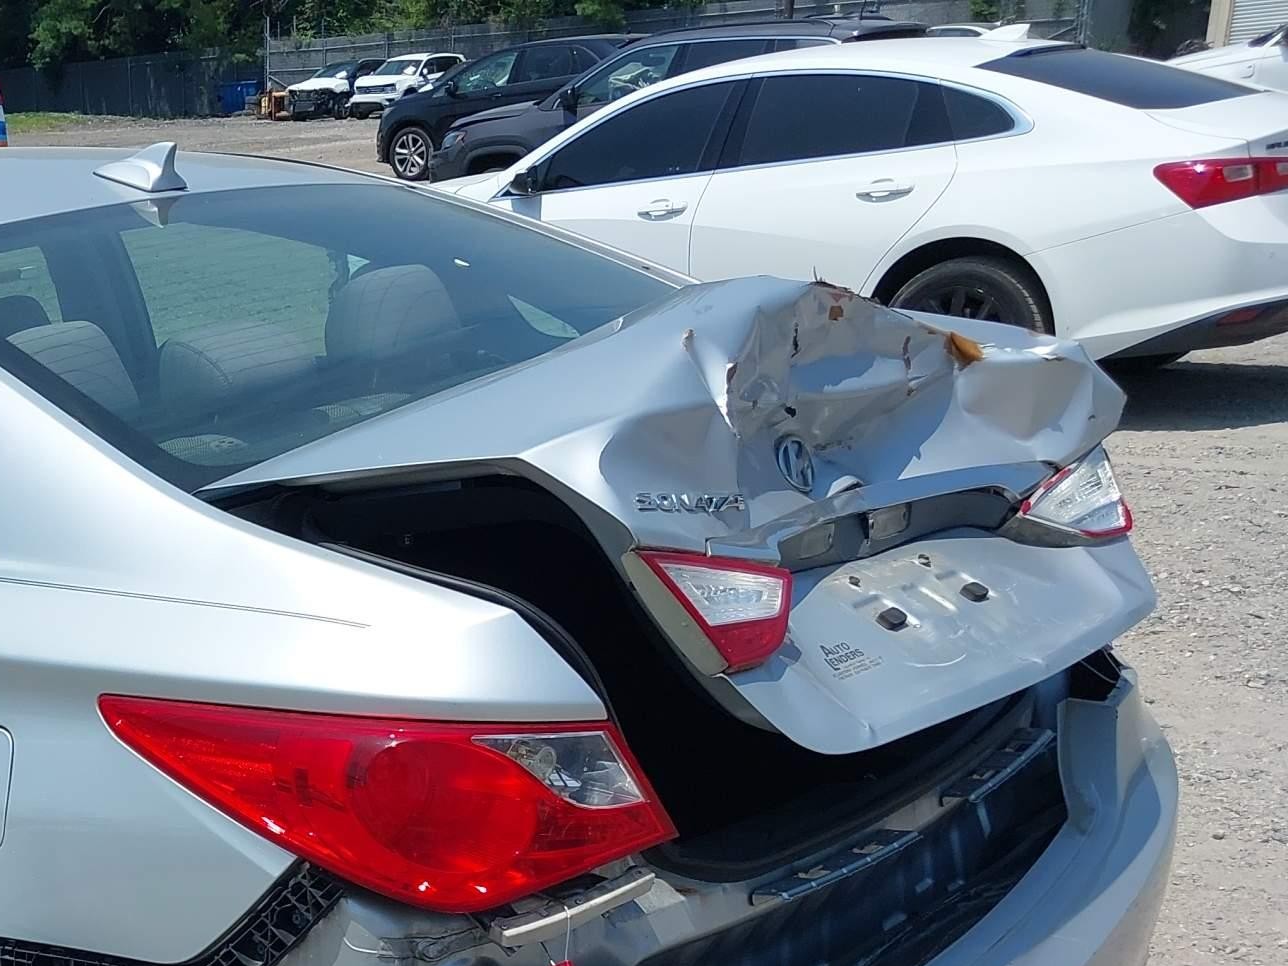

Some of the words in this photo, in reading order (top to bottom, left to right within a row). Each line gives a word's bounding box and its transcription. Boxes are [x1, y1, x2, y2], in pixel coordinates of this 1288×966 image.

[634, 493, 744, 515] SONATA
[819, 642, 850, 658] AUTO
[823, 649, 865, 671] LENDERS
